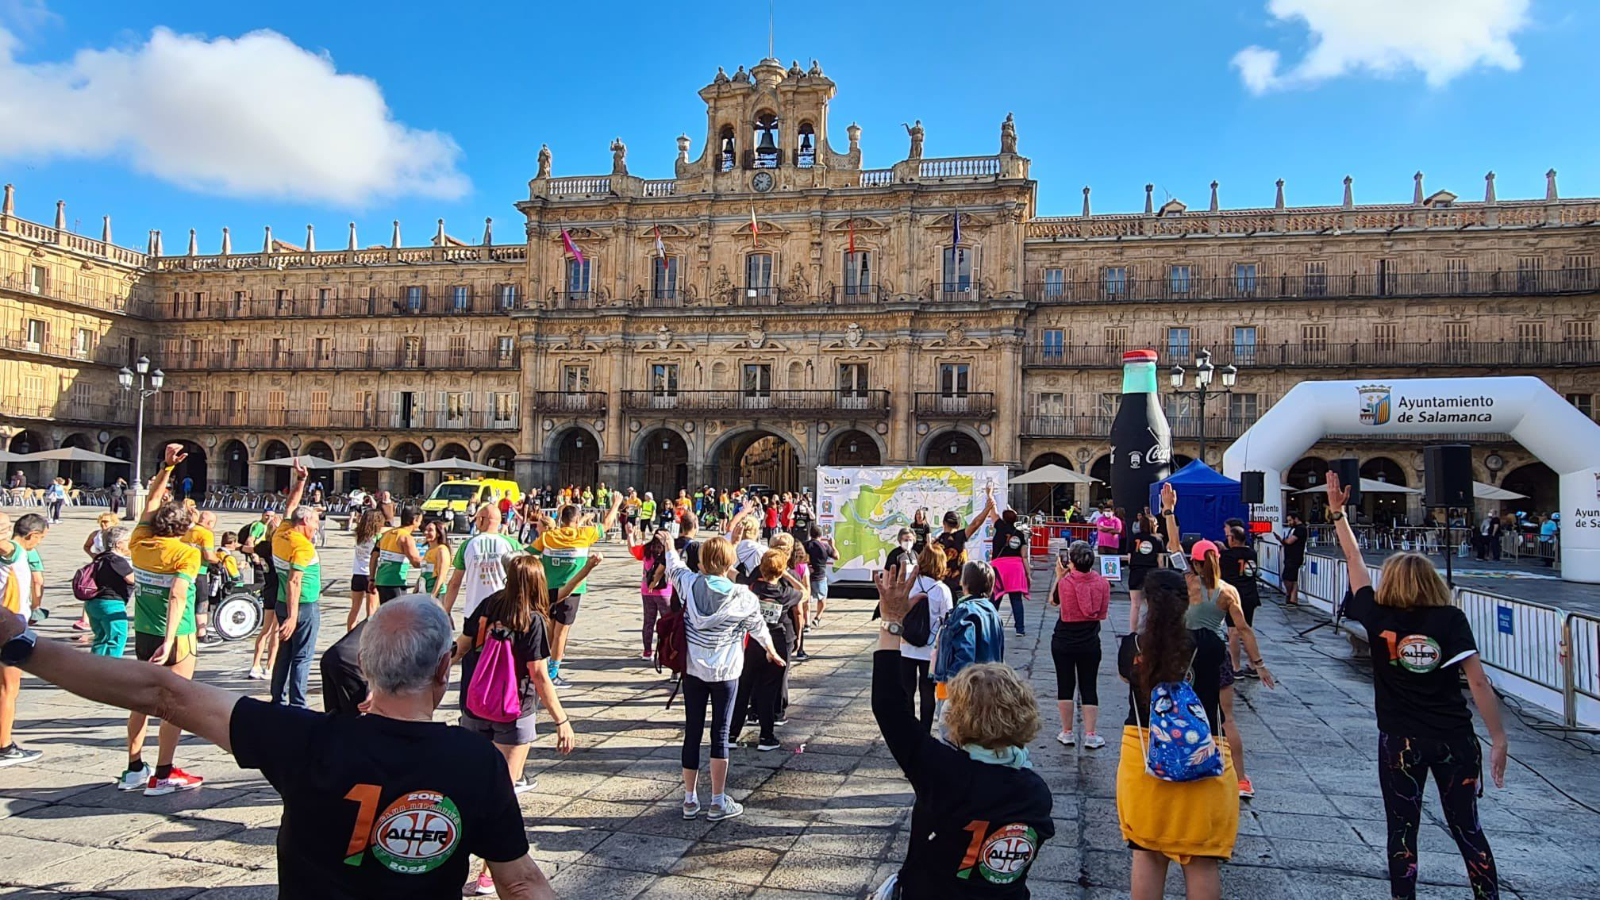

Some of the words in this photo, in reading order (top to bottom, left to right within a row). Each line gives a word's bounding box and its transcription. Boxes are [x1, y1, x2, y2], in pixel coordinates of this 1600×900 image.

[1398, 395, 1494, 411] Ayuntamiento
[1397, 411, 1414, 423] de
[1418, 411, 1492, 423] Salamanca
[824, 475, 851, 485] Savia
[1575, 519, 1587, 528] de
[1402, 651, 1436, 660] ALCER
[407, 793, 444, 803] 2012
[384, 828, 449, 845] ALCER
[988, 849, 1030, 862] ALCER
[389, 861, 427, 873] 2022
